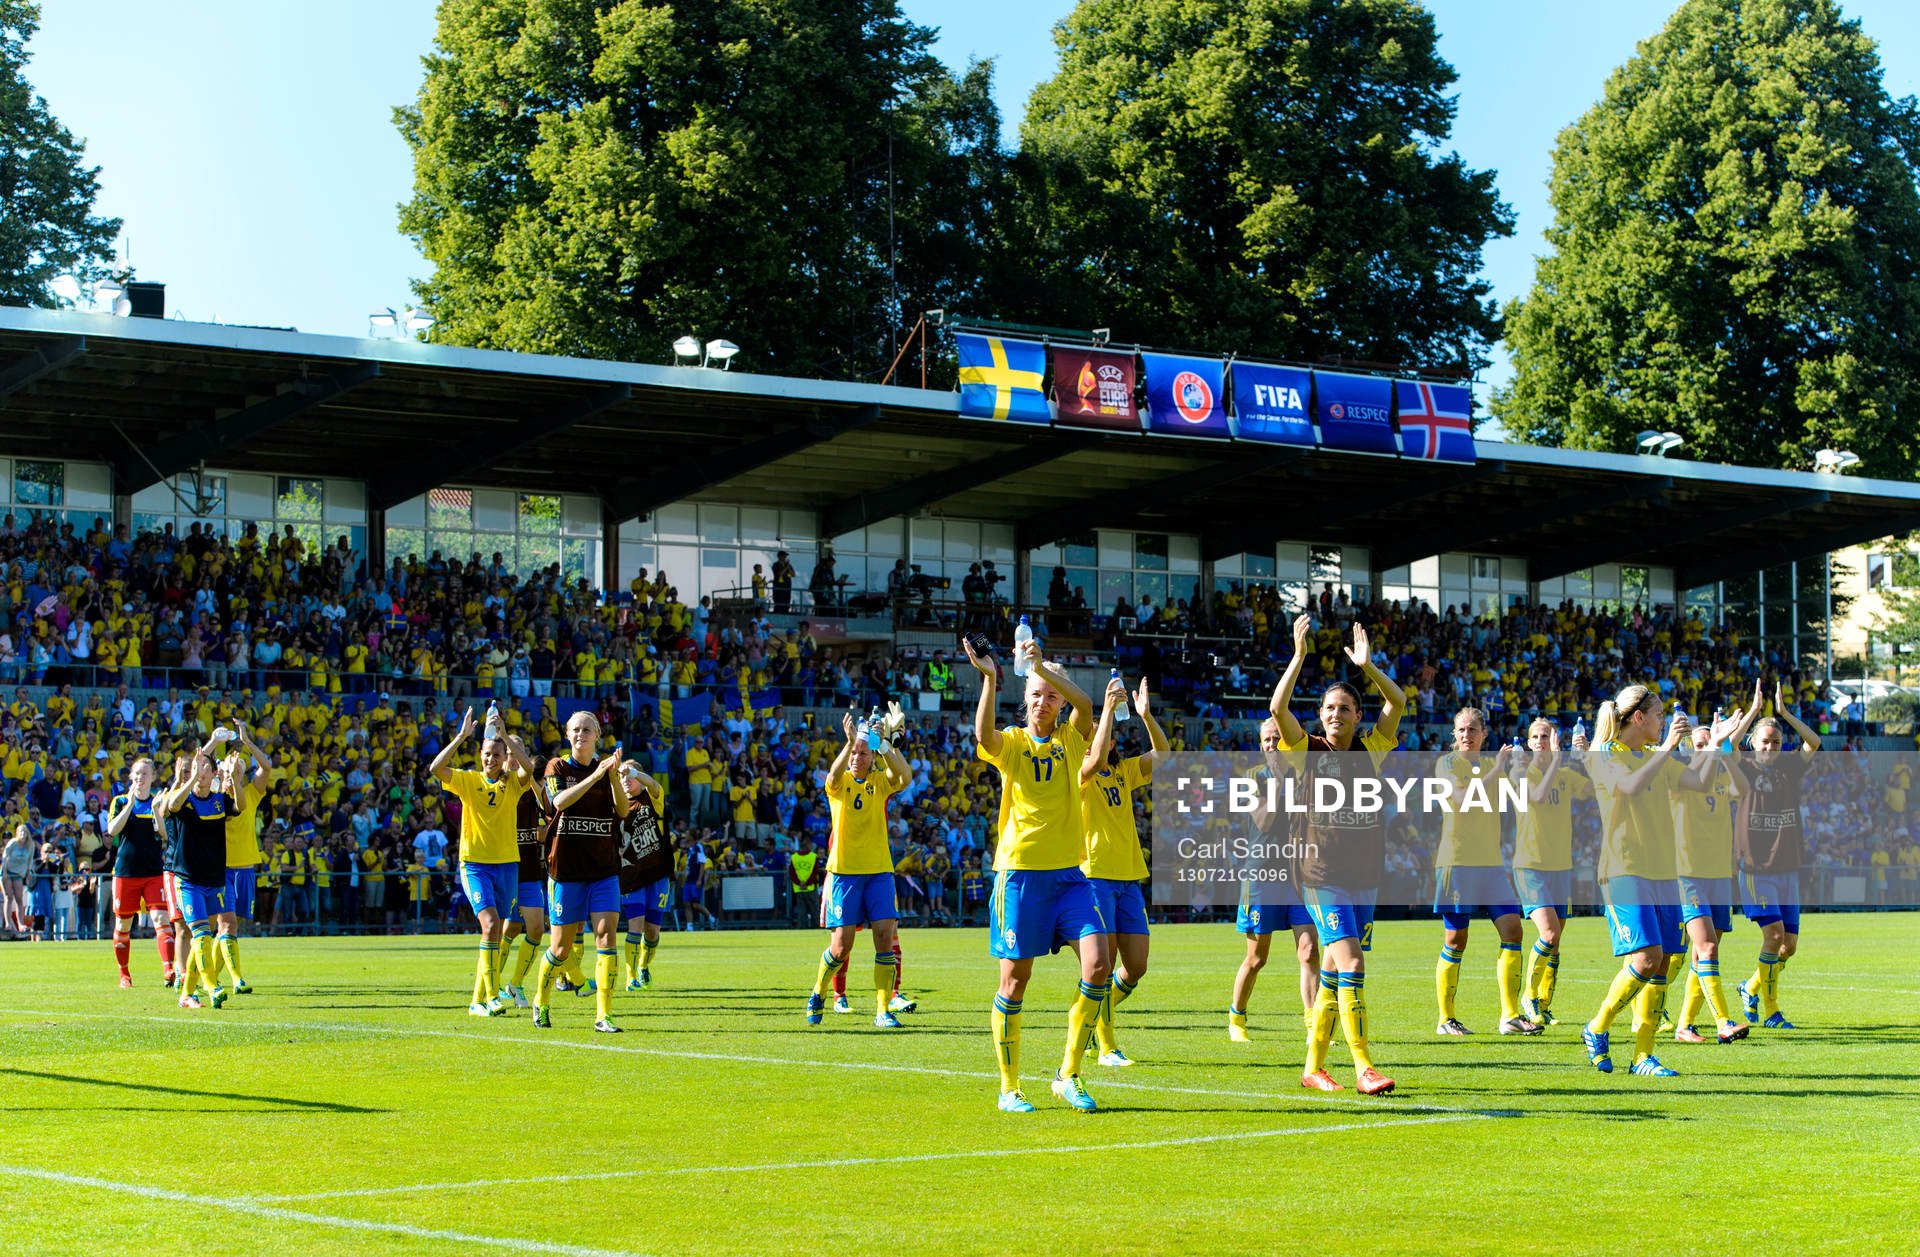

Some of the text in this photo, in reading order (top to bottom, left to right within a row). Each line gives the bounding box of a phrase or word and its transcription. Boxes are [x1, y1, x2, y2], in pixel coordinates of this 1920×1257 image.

[1100, 390, 1129, 409] EURO
[1254, 384, 1303, 411] FIFA
[1032, 756, 1053, 783] 17
[488, 791, 497, 807] 2
[853, 793, 863, 810] 6
[1103, 786, 1122, 807] 18
[1705, 796, 1716, 812] 9
[568, 820, 613, 833] RESPECT
